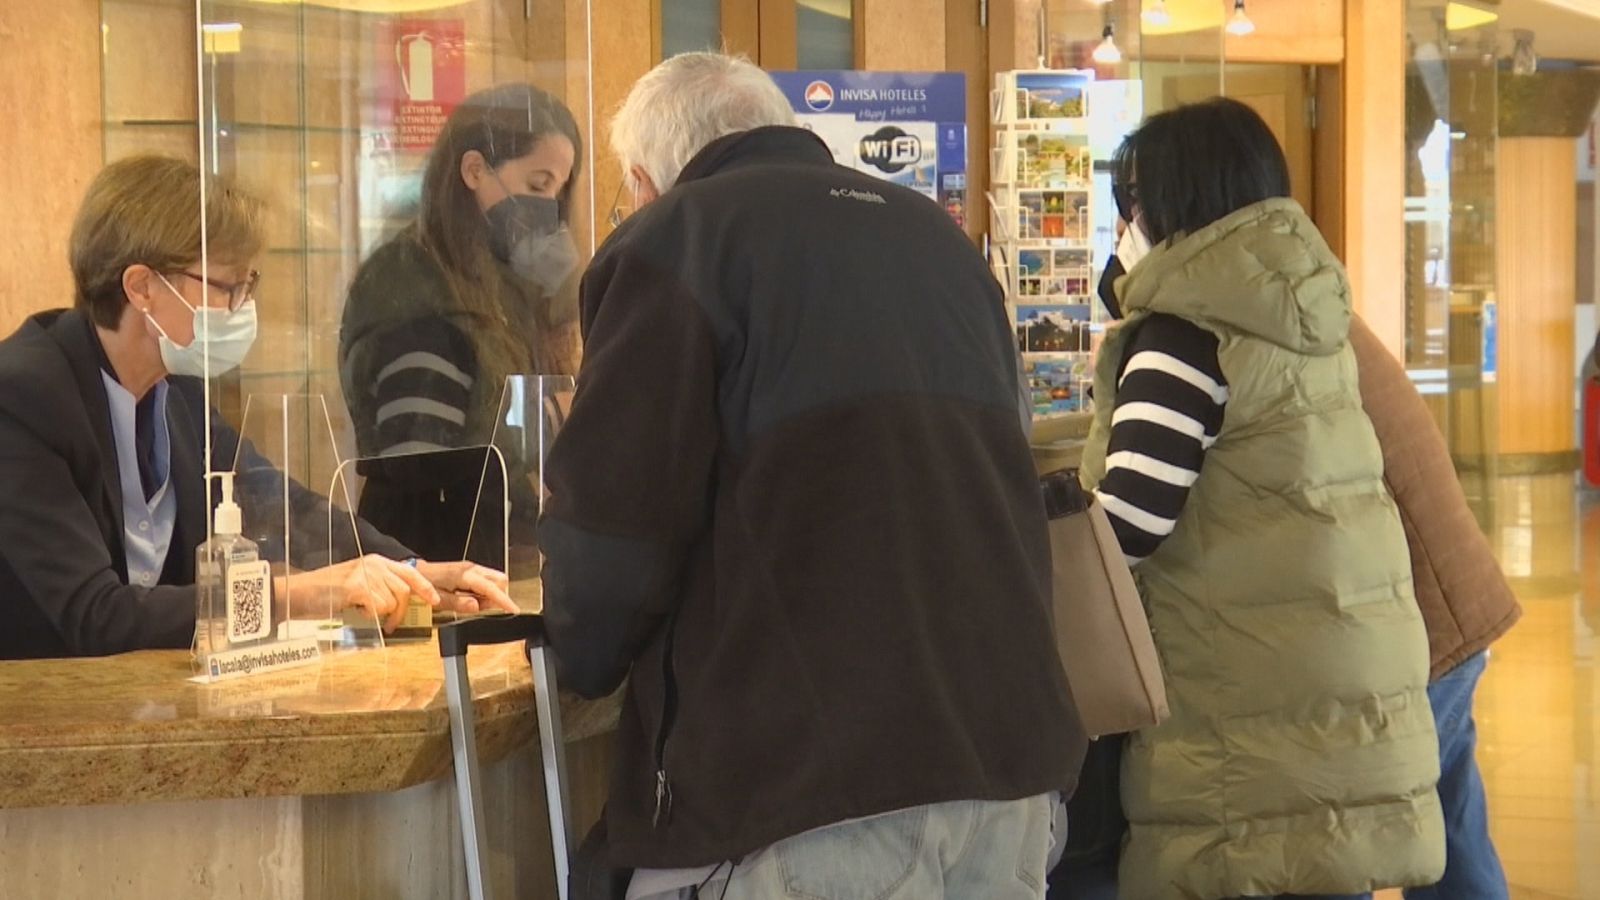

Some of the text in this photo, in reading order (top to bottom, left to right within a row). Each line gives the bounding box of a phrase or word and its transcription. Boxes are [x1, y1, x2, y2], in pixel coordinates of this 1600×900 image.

[840, 89, 927, 101] INVISA HOTELES
[865, 140, 915, 158] WiFi
